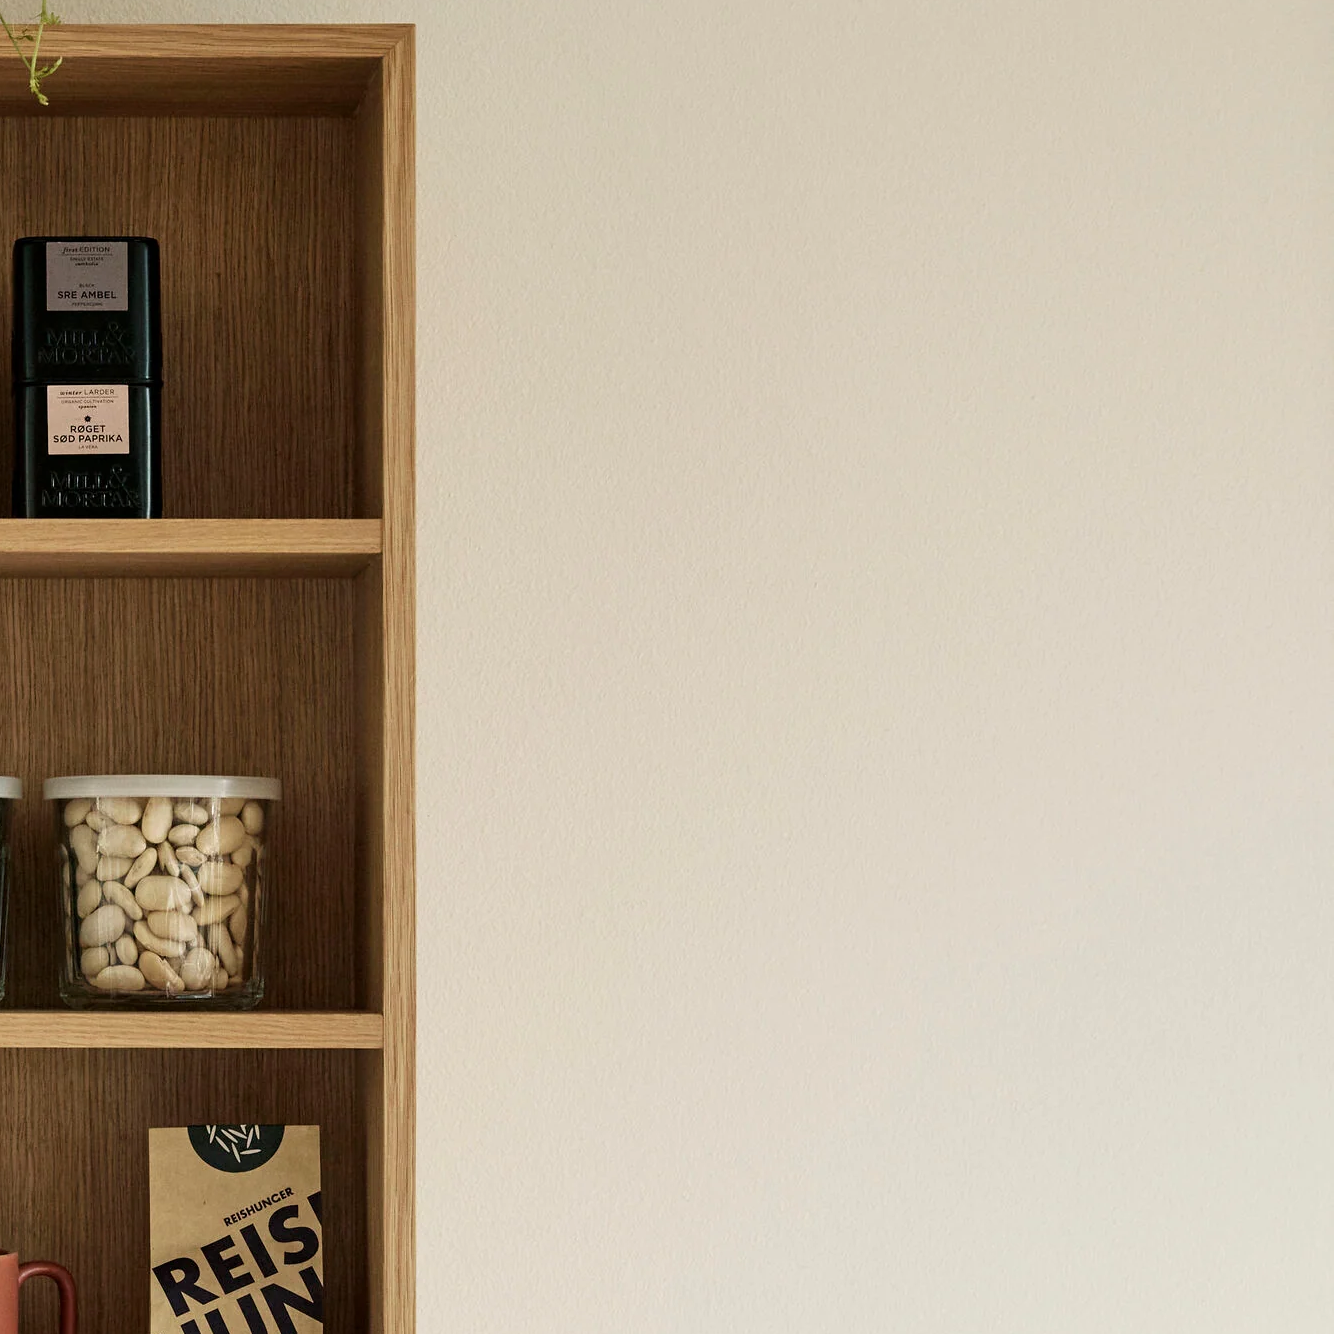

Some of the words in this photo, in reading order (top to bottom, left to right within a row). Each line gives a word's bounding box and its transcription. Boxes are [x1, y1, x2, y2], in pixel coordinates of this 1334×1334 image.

[57, 291, 77, 299] SRE
[81, 291, 117, 299] AMBEL
[70, 425, 106, 433] RØGET
[53, 435, 75, 443] SØD
[79, 434, 123, 443] PAPRIKA
[223, 1186, 295, 1227] REISHUNGER
[151, 1190, 322, 1317] REIS
